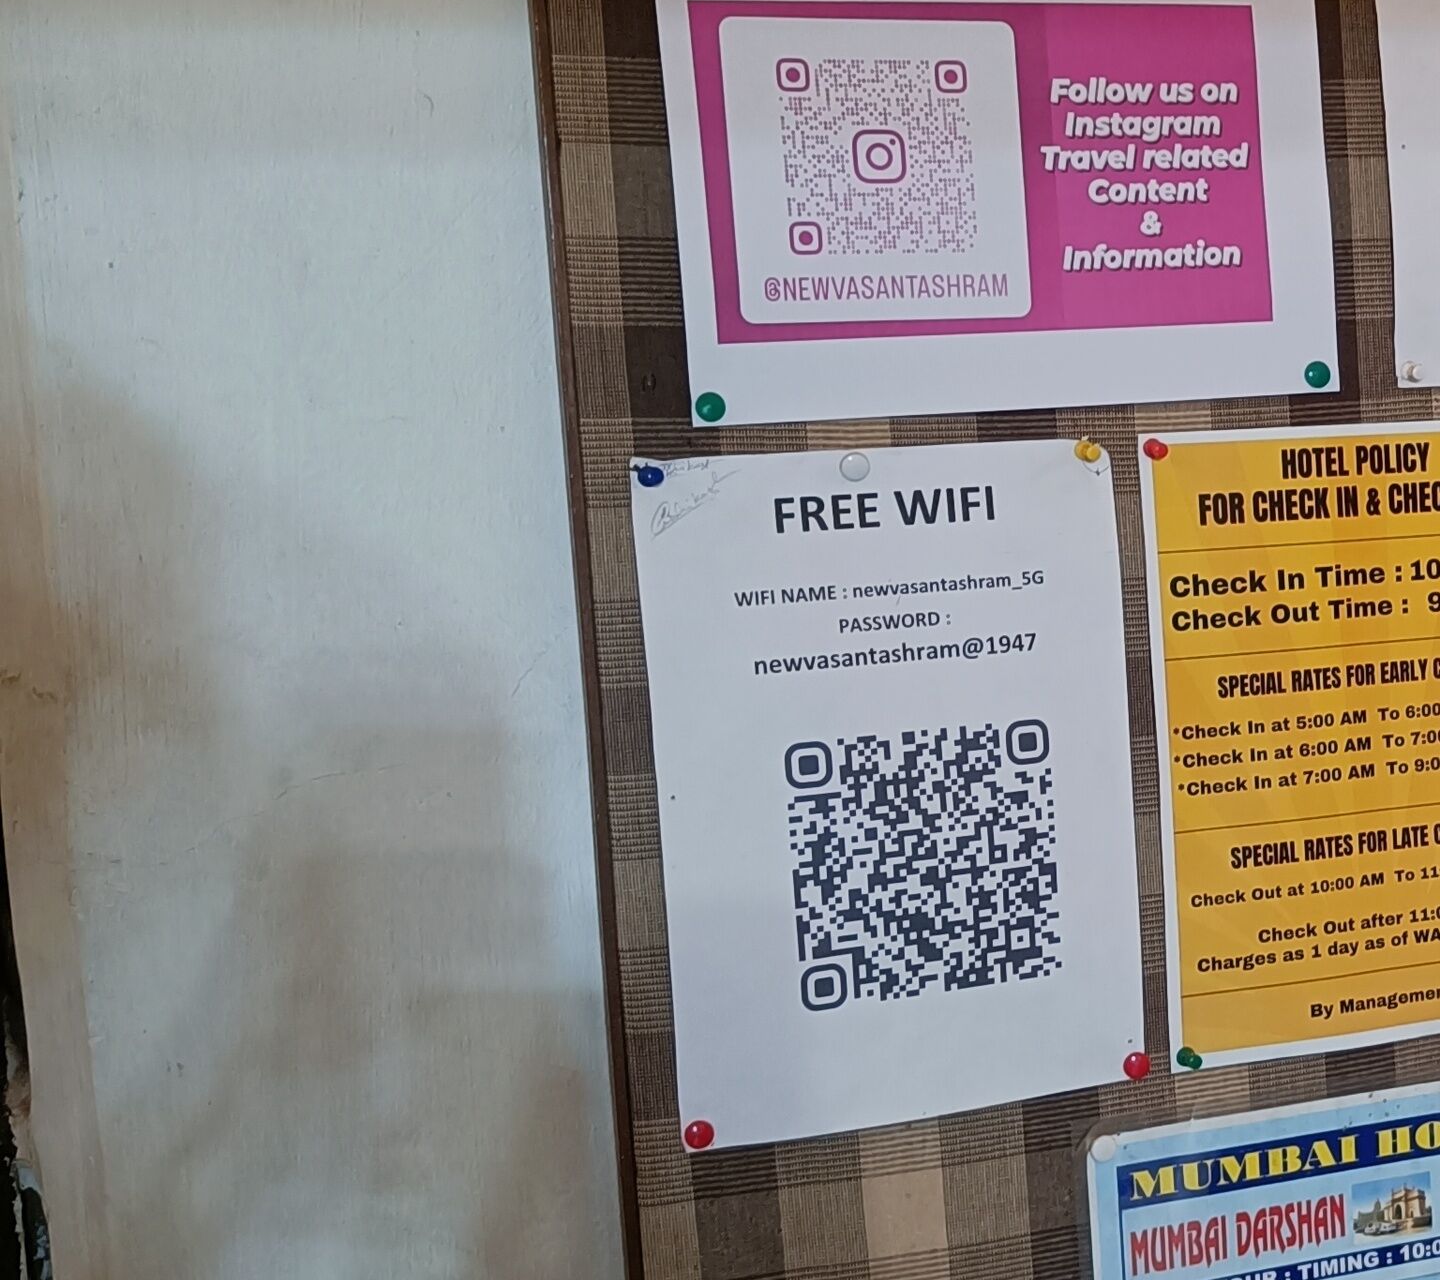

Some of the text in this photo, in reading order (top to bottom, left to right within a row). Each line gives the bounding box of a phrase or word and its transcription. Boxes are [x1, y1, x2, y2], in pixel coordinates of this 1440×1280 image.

[1049, 76, 1238, 103] Follow us on
[1064, 110, 1220, 142] Instagram
[1039, 141, 1249, 171] Travel related
[1087, 177, 1208, 203] Content
[1139, 209, 1162, 235] &
[1062, 239, 1241, 270] Information
[763, 272, 1008, 302] @NEWVASANTASHRAM
[1280, 441, 1430, 479] HOTEL POLICY
[773, 491, 881, 534] FREE
[892, 484, 995, 526] WIFI
[1197, 491, 1245, 526] FOR
[1251, 486, 1331, 523] CHECK
[1335, 484, 1359, 518] IN
[1365, 486, 1381, 516] &
[733, 588, 775, 607] WIFI
[780, 584, 837, 604] NAME
[851, 569, 1044, 598] newvasantashram_5G
[1168, 568, 1267, 598] Check
[1276, 568, 1305, 591] In
[1313, 563, 1385, 588] Time
[838, 610, 940, 634] PASSWORD
[753, 631, 1036, 675] newvasantashram@1947
[1216, 670, 1287, 699] SPECIAL
[1290, 665, 1341, 693] RATES
[1345, 662, 1376, 688] FOR
[1379, 657, 1428, 684] EARLY
[1309, 1002, 1334, 1020] By
[1129, 1133, 1358, 1201] MUMBAI
[1129, 1192, 1346, 1276] MUMBAI DARSHAN
[1296, 1250, 1379, 1280] TIMING
